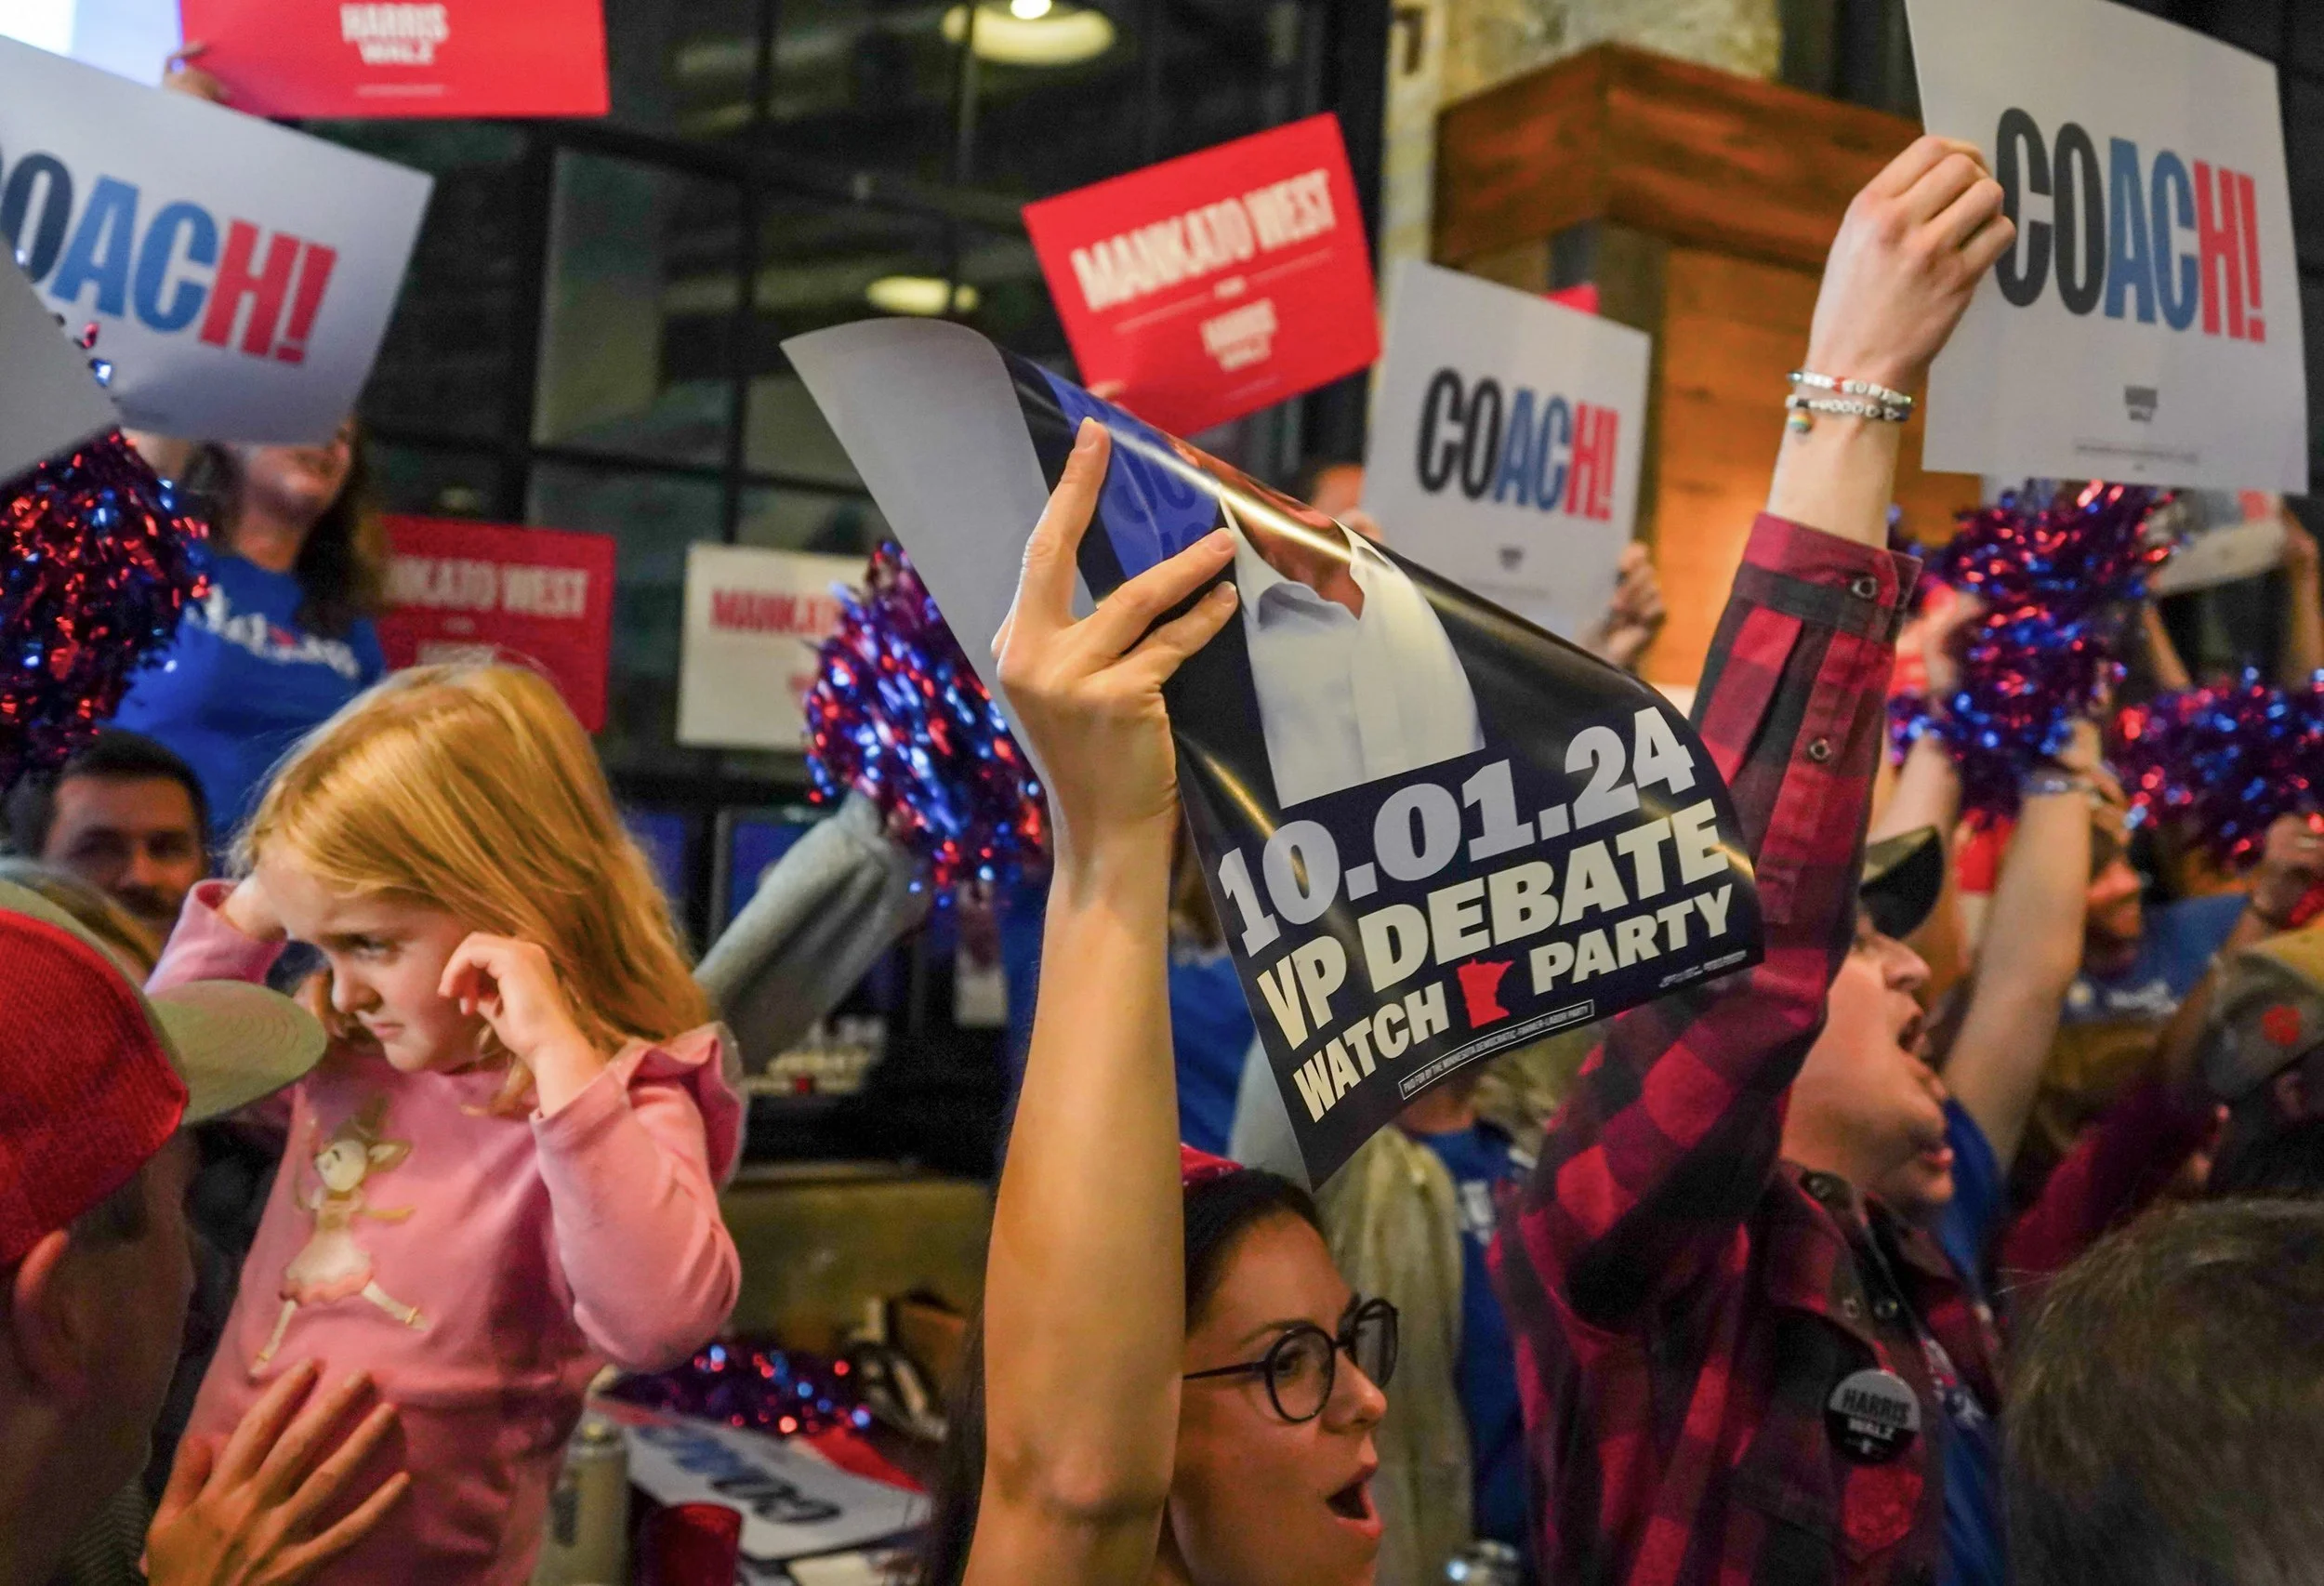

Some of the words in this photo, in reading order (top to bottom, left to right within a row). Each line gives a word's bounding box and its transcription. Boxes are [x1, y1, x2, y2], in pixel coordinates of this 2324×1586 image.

[0, 149, 337, 363] OACH!
[1070, 197, 1255, 313] MANKATO
[1242, 167, 1337, 251] WEST
[1995, 107, 2266, 344] COACH!
[1417, 366, 1619, 523] COACH!
[502, 562, 590, 619] WEST
[1217, 706, 1696, 958] 10.01.24
[1256, 934, 1347, 1051] VP
[1356, 798, 1730, 994] DEBATE
[1292, 980, 1450, 1124] WATCH
[1529, 882, 1733, 997] PARTY
[1843, 1388, 1912, 1429] HARRIS
